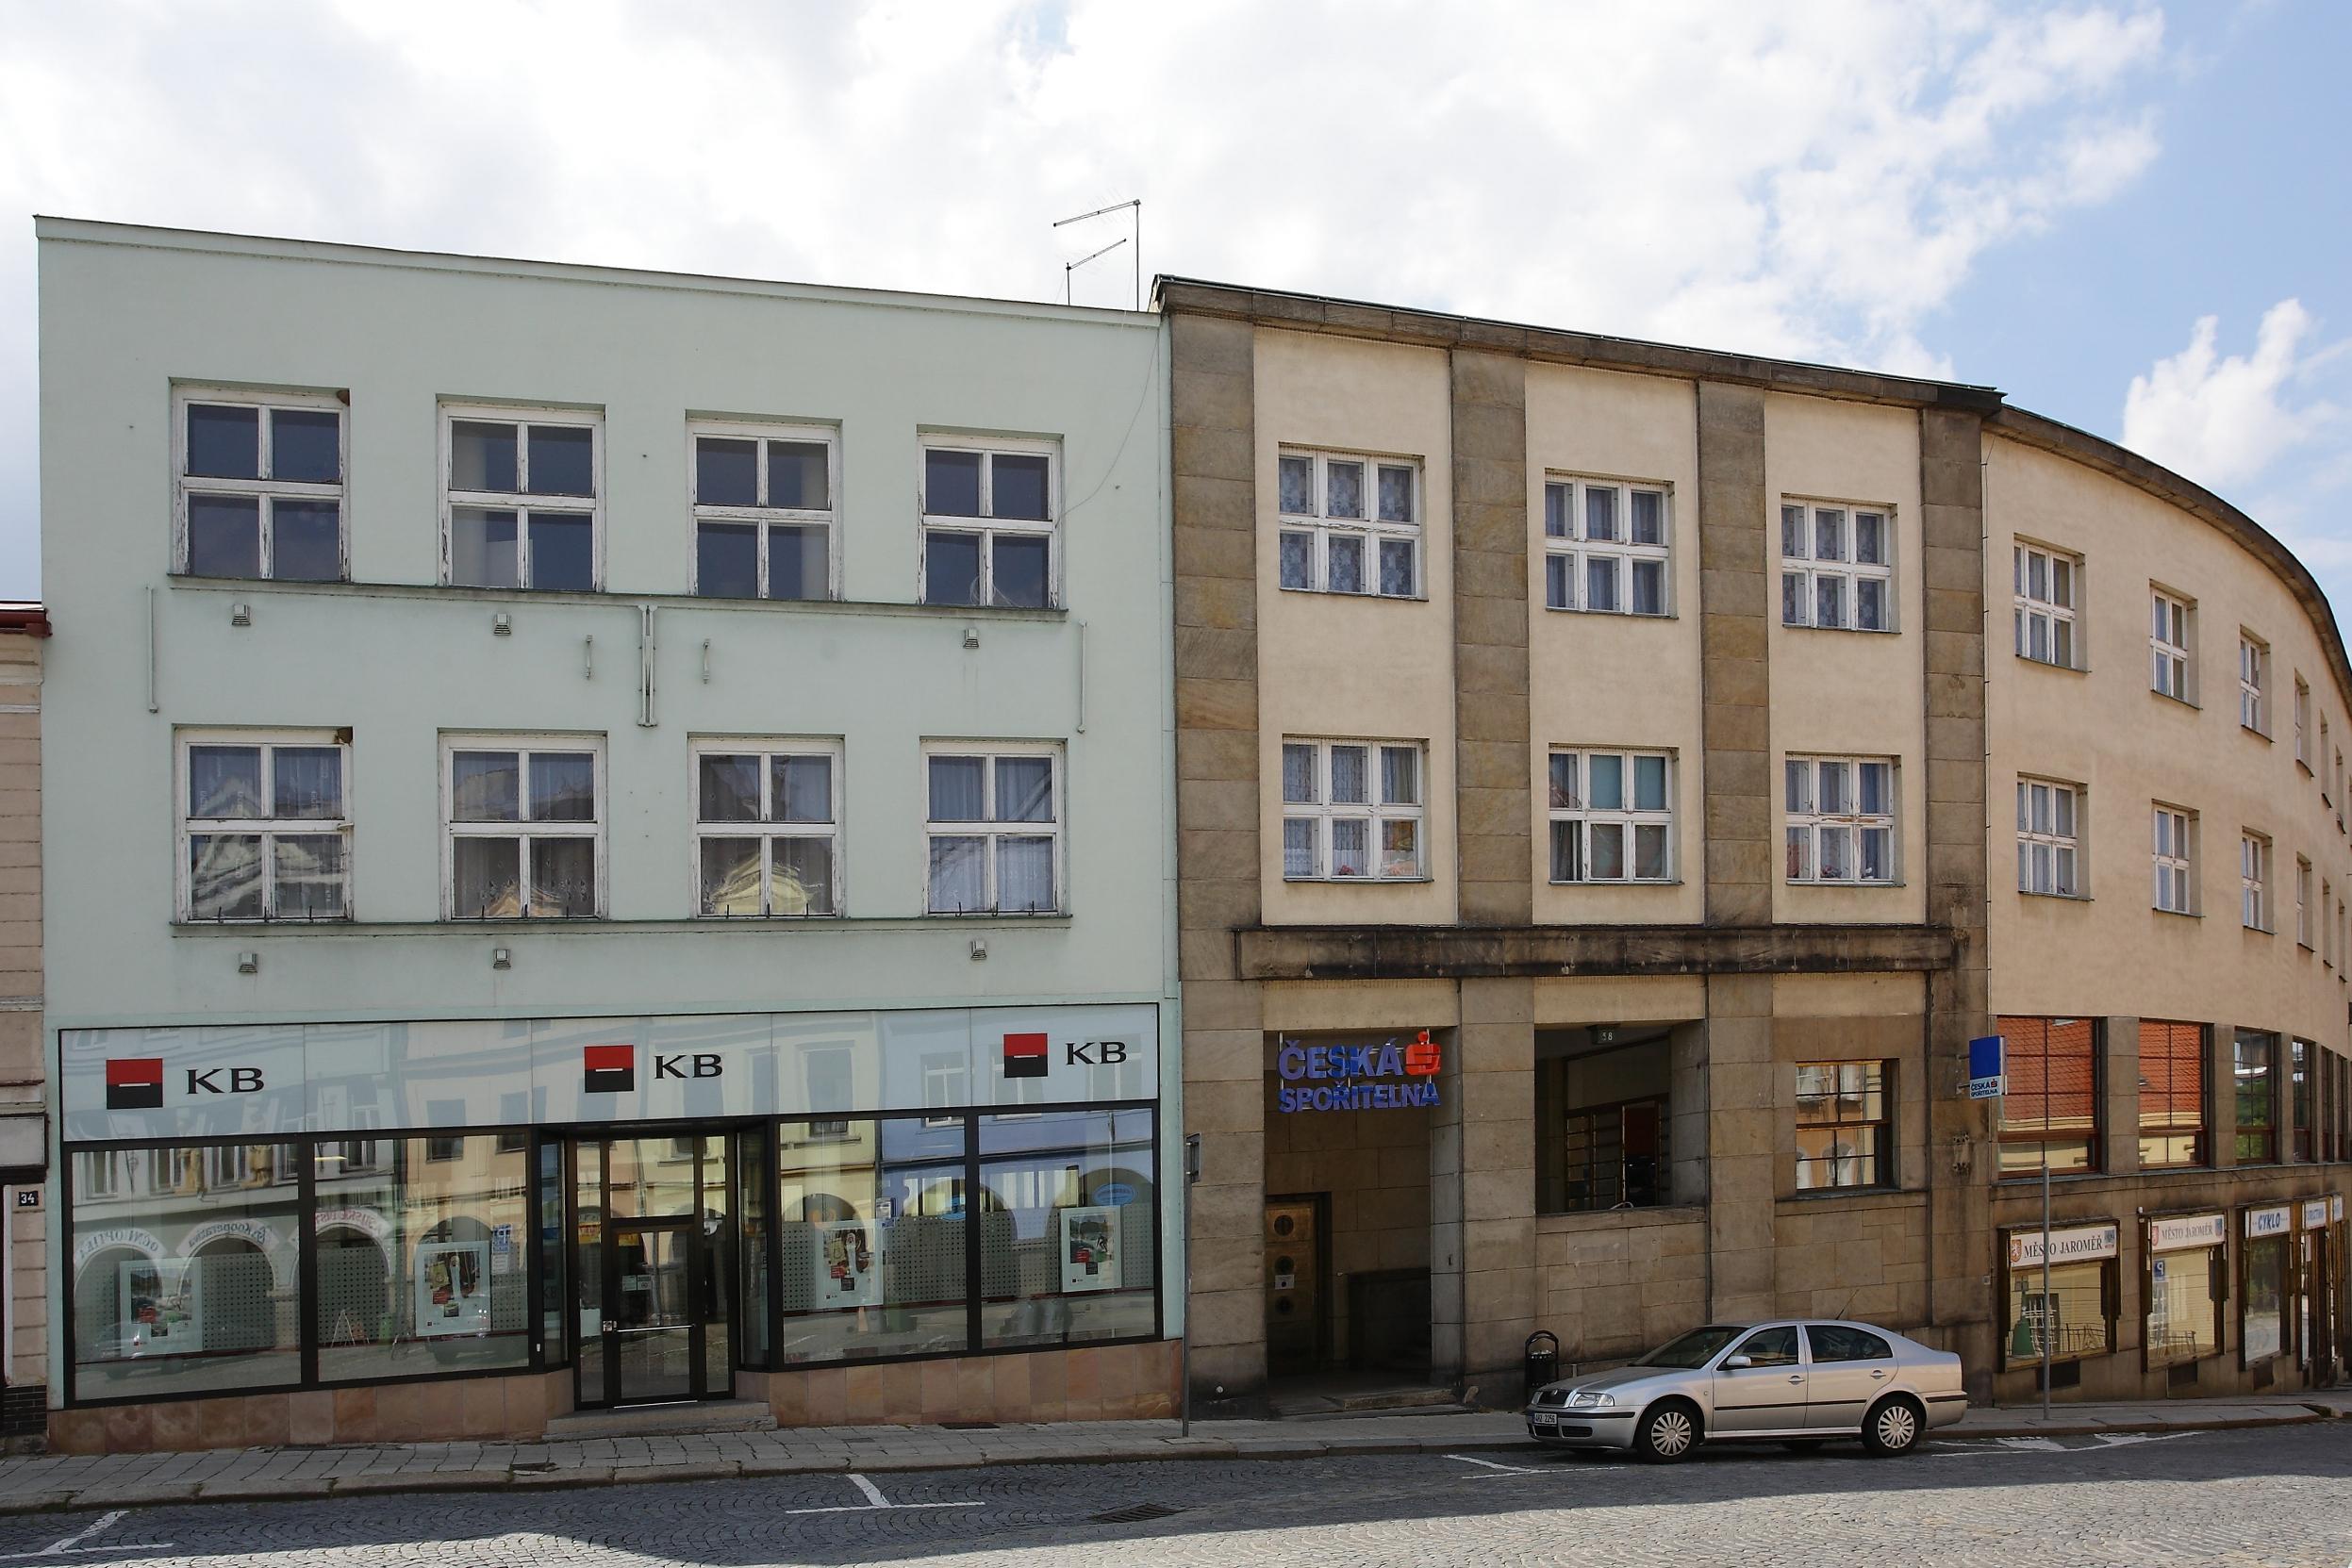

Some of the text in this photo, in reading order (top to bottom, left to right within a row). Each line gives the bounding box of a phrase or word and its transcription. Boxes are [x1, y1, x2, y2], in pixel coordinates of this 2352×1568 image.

[1066, 1041, 1127, 1065] KB
[1279, 1037, 1403, 1081] ČESKÁ
[654, 1053, 723, 1080] KB
[186, 1067, 265, 1095] KB
[1279, 1081, 1441, 1114] SPOŘITELNA
[21, 1193, 35, 1204] 34
[2162, 1227, 2183, 1240] MĚSTO
[2258, 1213, 2280, 1230] CYKLO
[2024, 1235, 2103, 1259] MĚSO JAROMĚŘ
